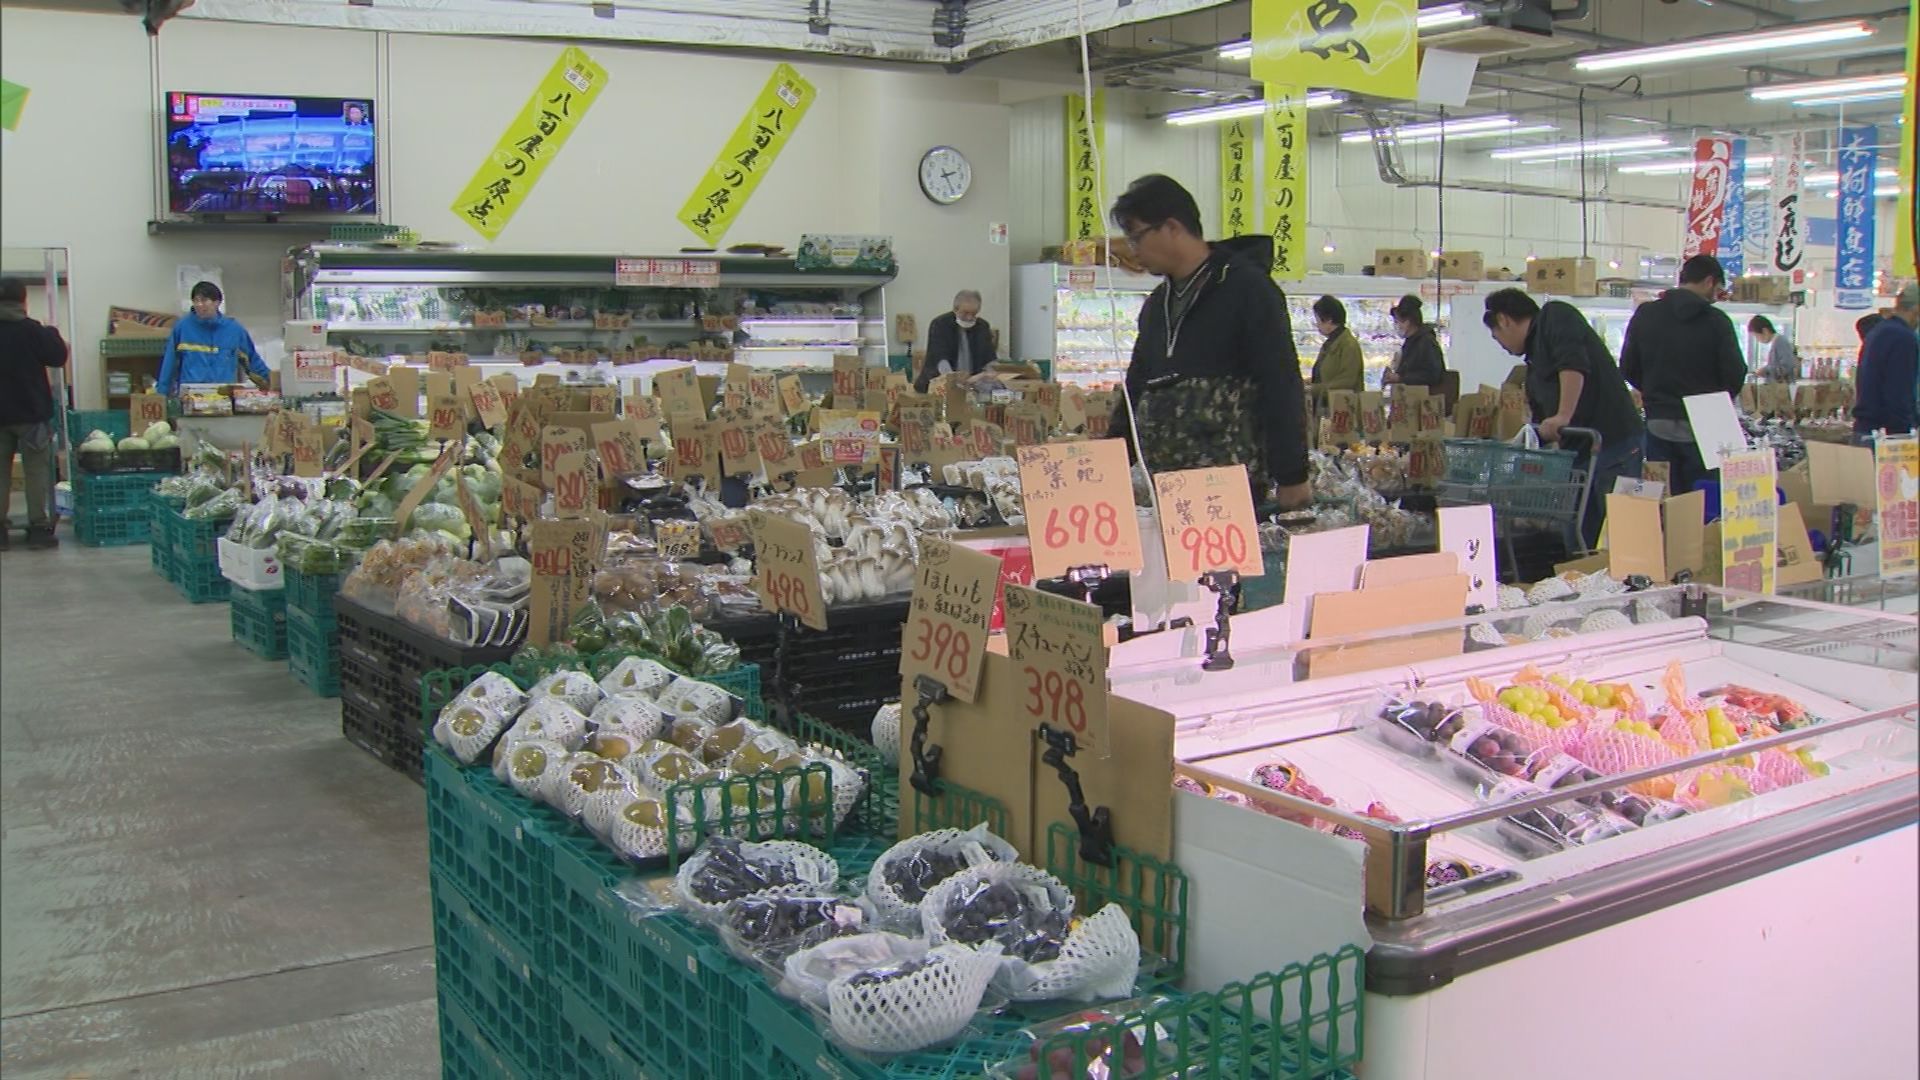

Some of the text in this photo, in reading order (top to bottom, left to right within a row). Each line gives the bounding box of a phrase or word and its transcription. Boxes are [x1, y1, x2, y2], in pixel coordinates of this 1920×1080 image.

[467, 92, 572, 227] 八百屋の原点
[692, 107, 784, 235] 八百屋の原点
[1270, 94, 1296, 273] 八百屋の原点
[1044, 501, 1120, 549] 698
[1180, 522, 1248, 572] 980
[766, 569, 810, 614] 498
[923, 568, 983, 605] ほしいも
[911, 617, 971, 680] 398
[1014, 620, 1094, 663] スチューベン
[1024, 666, 1087, 732] 398
